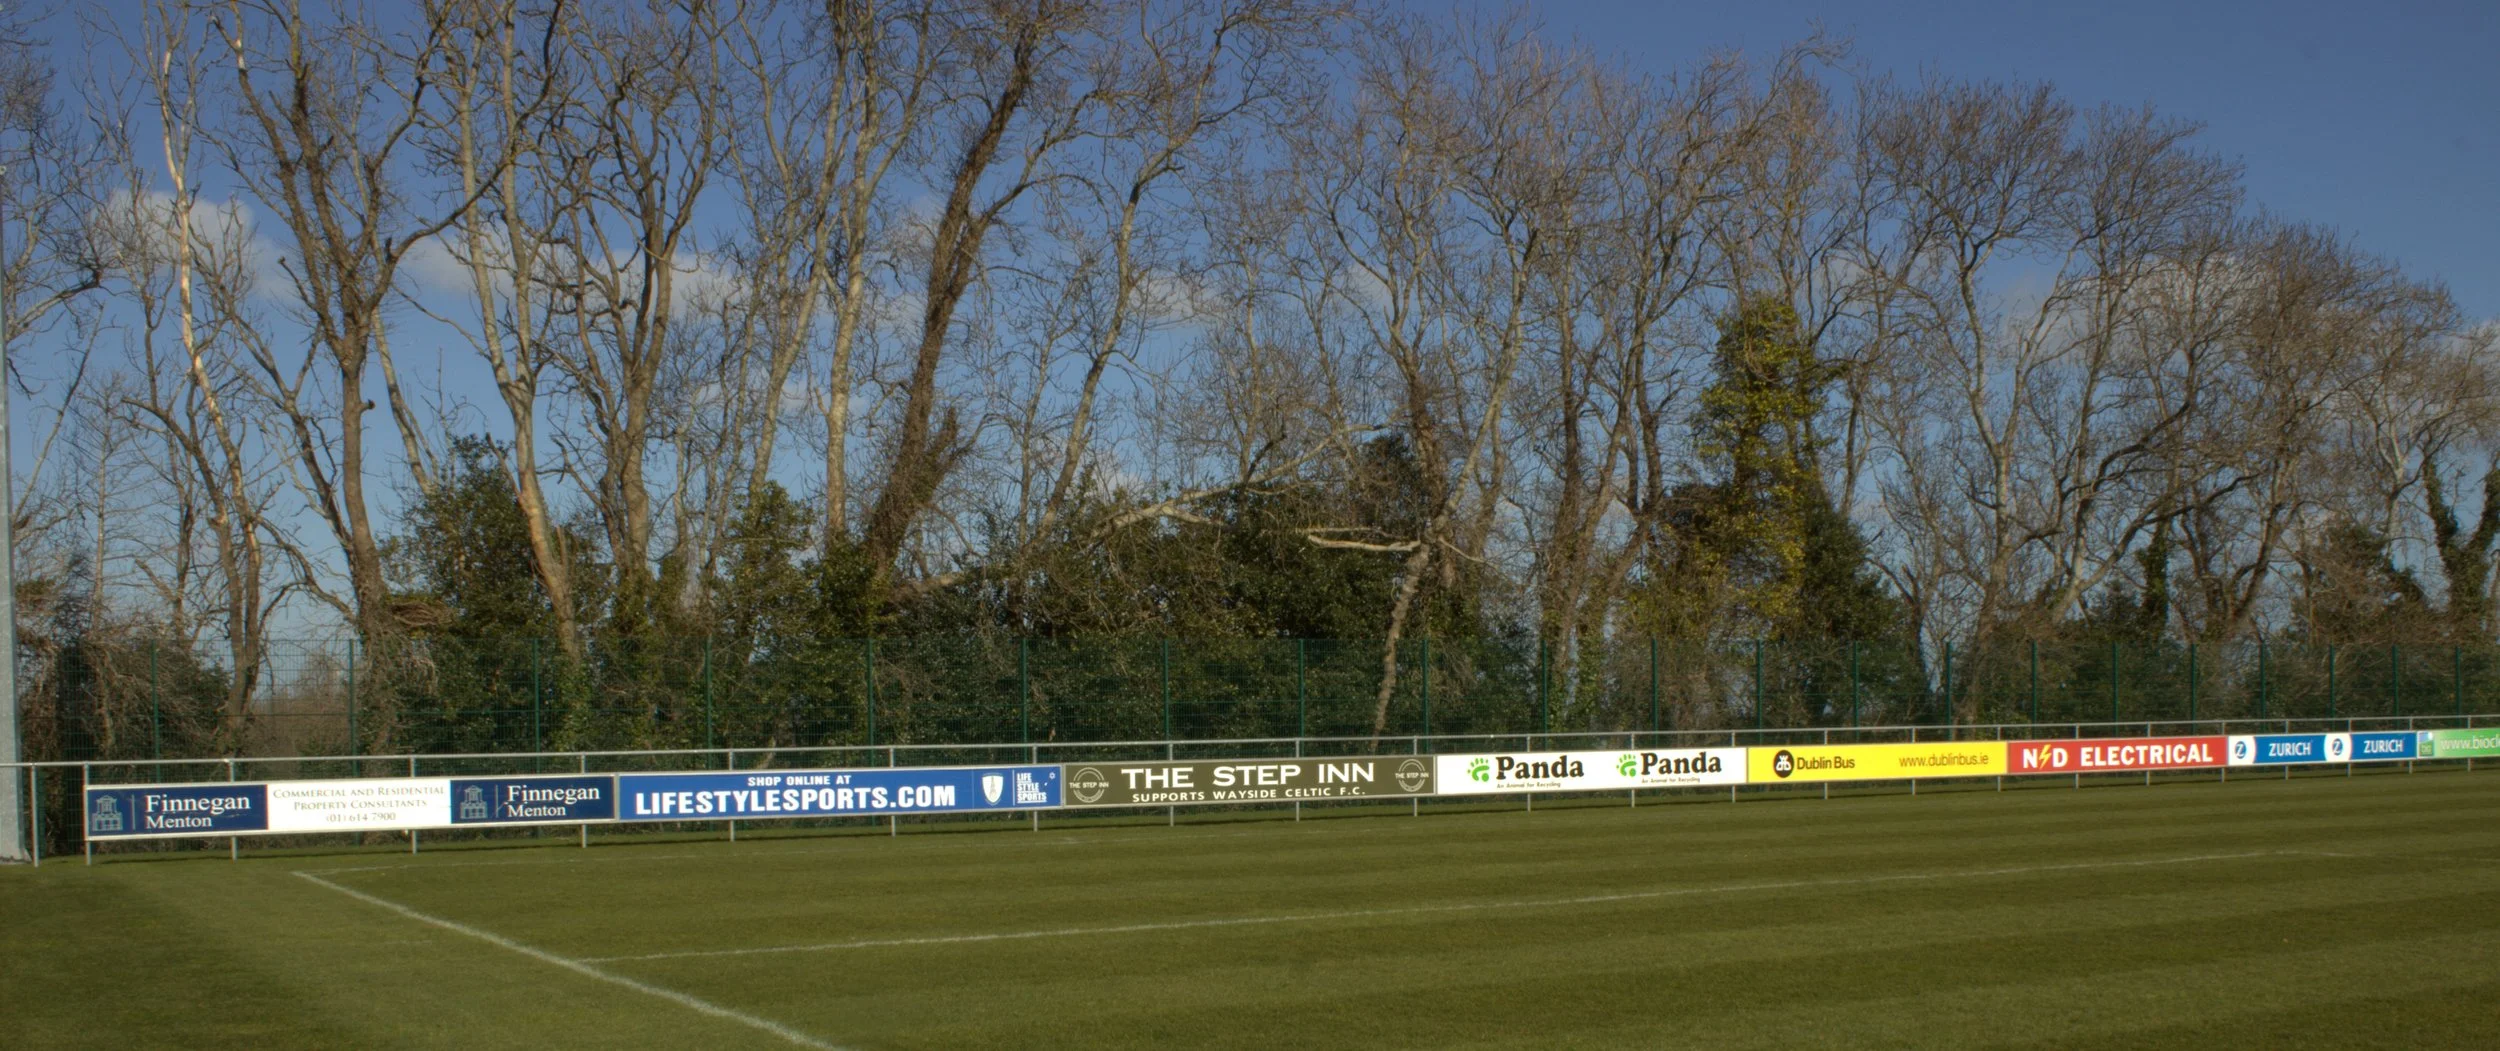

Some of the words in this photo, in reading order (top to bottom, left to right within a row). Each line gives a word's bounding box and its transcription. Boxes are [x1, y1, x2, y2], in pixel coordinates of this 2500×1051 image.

[2268, 742, 2312, 757] ZURICH
[2363, 739, 2404, 754] ZURICH
[1899, 752, 1989, 767] www.dublinbus.ie
[2080, 743, 2214, 767] ELECTRICAL
[1496, 755, 1585, 780] Panda
[1640, 751, 1722, 775] Panda
[1797, 756, 1832, 770] Dublin
[1834, 756, 1856, 769] Bus
[748, 776, 781, 787] SHOP
[786, 775, 831, 786] ONLINE
[836, 775, 852, 785] AT
[1016, 772, 1032, 781] LIFE
[1121, 767, 1194, 790] THE
[1212, 764, 1301, 787] STEP
[1318, 762, 1375, 784] INN
[1017, 782, 1039, 791] STYLE
[1069, 781, 1081, 789] THE
[1082, 781, 1098, 789] STEP
[507, 784, 600, 804] Finnegan
[636, 785, 955, 815] LIFESTYLESPORTS.COM
[1017, 791, 1047, 801] SPORTS
[1132, 791, 1205, 803] SUPPORTS
[1213, 789, 1277, 801] WAYSIDE
[1285, 787, 1331, 798] CELTIC
[1340, 786, 1366, 796] F.C.
[145, 794, 251, 815] Finnegan
[507, 804, 566, 817] Menton
[145, 815, 212, 829] Menton
[349, 813, 368, 823] 614
[372, 811, 396, 821] 7900
